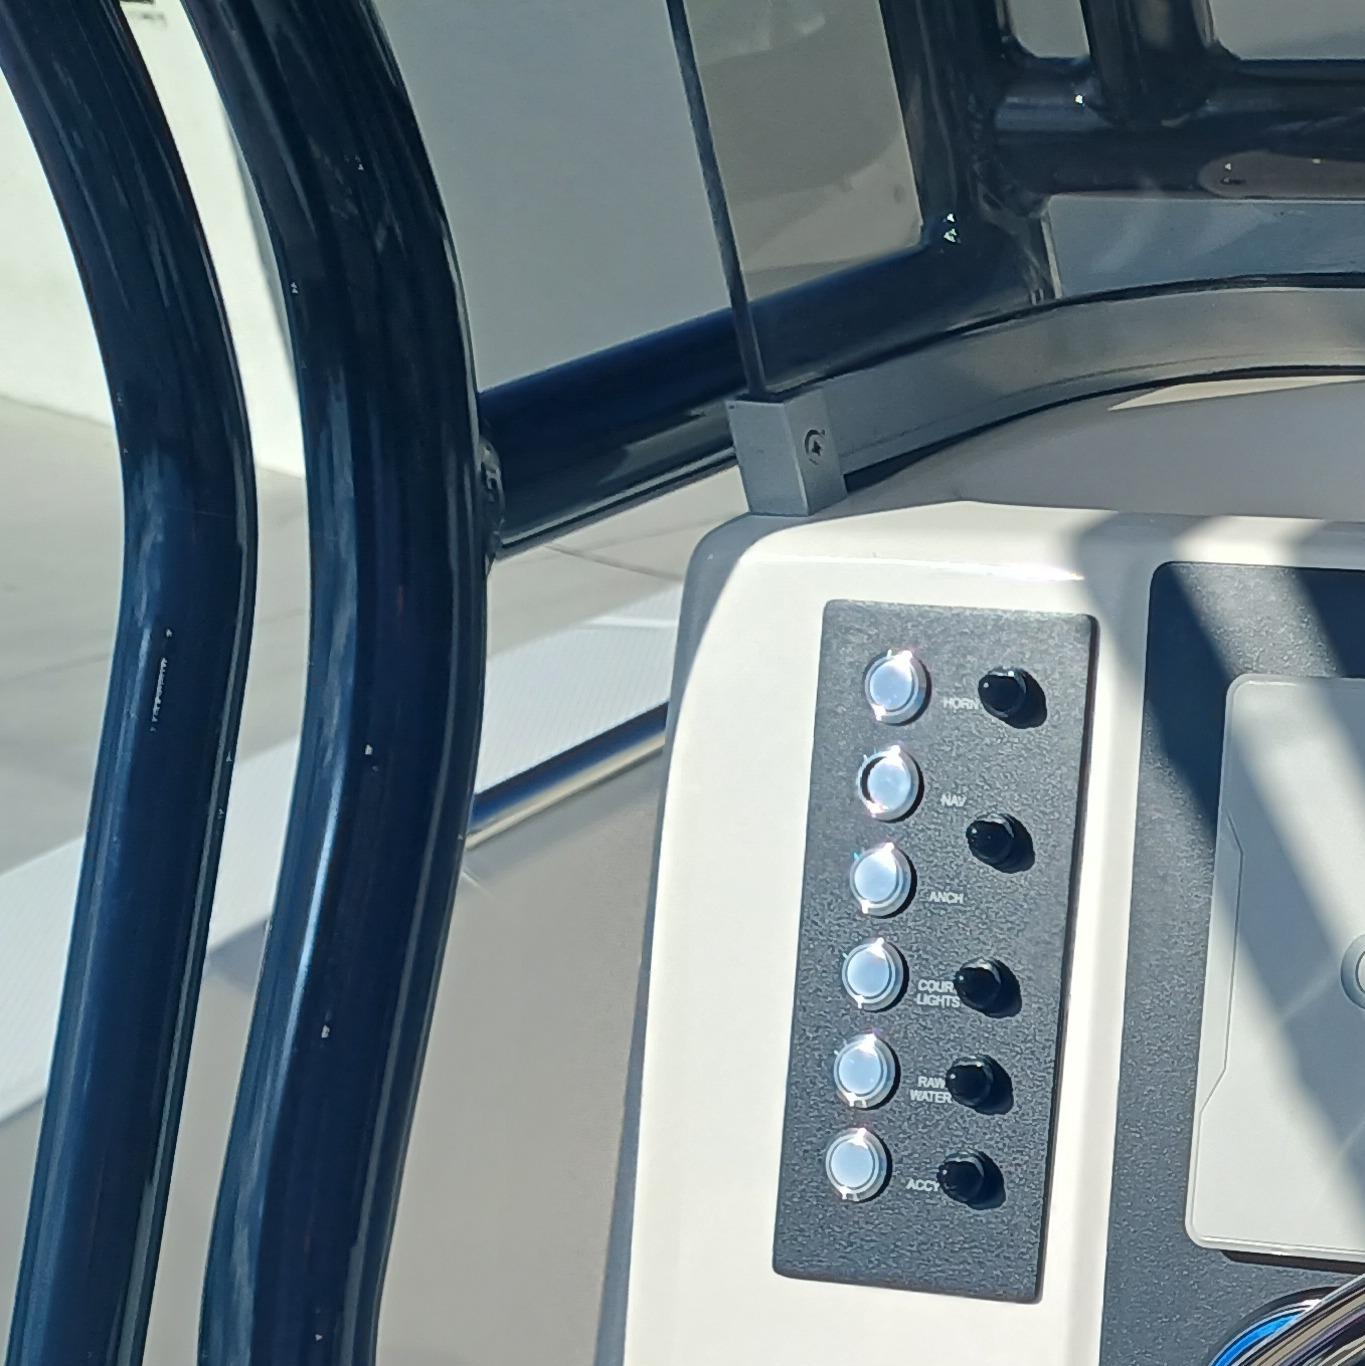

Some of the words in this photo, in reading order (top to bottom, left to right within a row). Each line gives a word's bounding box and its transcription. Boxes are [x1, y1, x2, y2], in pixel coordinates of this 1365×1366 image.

[943, 696, 980, 710] HORN
[940, 792, 967, 807] NAV
[929, 891, 964, 905] ANCH
[916, 992, 961, 1008] LIGHTS
[917, 1075, 946, 1089] RAW
[909, 1088, 953, 1104] WATER
[905, 1177, 940, 1191] ACCY
